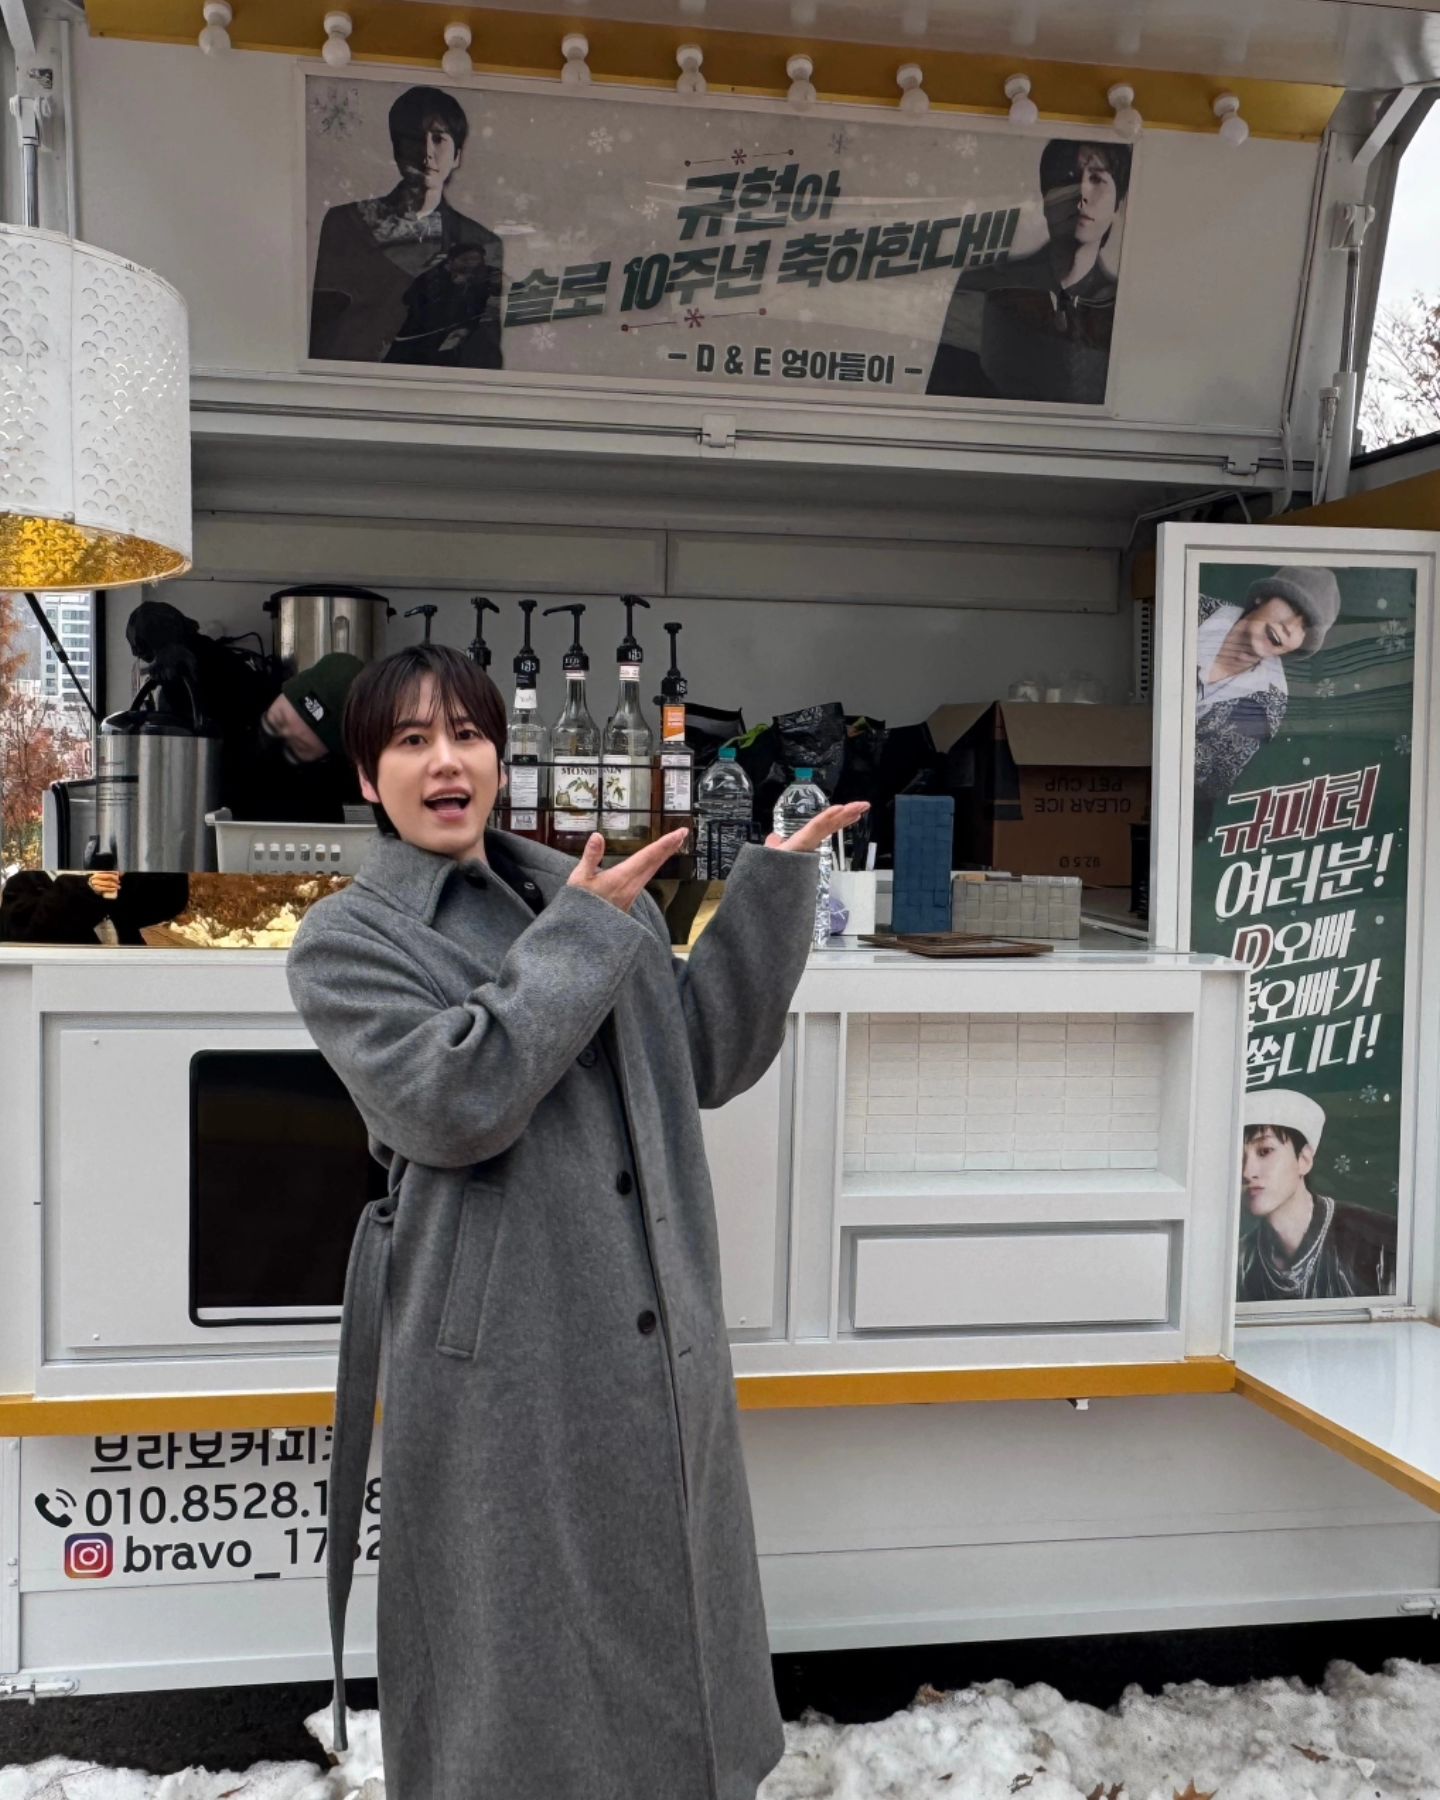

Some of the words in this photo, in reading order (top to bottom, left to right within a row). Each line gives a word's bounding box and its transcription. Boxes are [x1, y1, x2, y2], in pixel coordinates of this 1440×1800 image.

[678, 164, 841, 240] 규현아
[504, 261, 611, 328] 솔로
[620, 240, 771, 313] 10주년
[777, 208, 1020, 287] 축하한다!!!
[697, 344, 715, 372] D
[724, 345, 743, 375] &
[754, 348, 771, 376] E
[782, 349, 894, 384] 엉아들이
[1034, 797, 1064, 814] ICE
[1045, 777, 1082, 793] CUP
[1070, 797, 1131, 814] CLEAR
[1088, 778, 1122, 793] PET
[1215, 764, 1381, 857] 규피터
[1215, 833, 1393, 918] 여러분!
[1231, 909, 1357, 974] D오빠
[91, 1425, 333, 1473] 브라보커피
[85, 1477, 382, 1527] 010.8528.18
[123, 1524, 382, 1580] bravo_172
